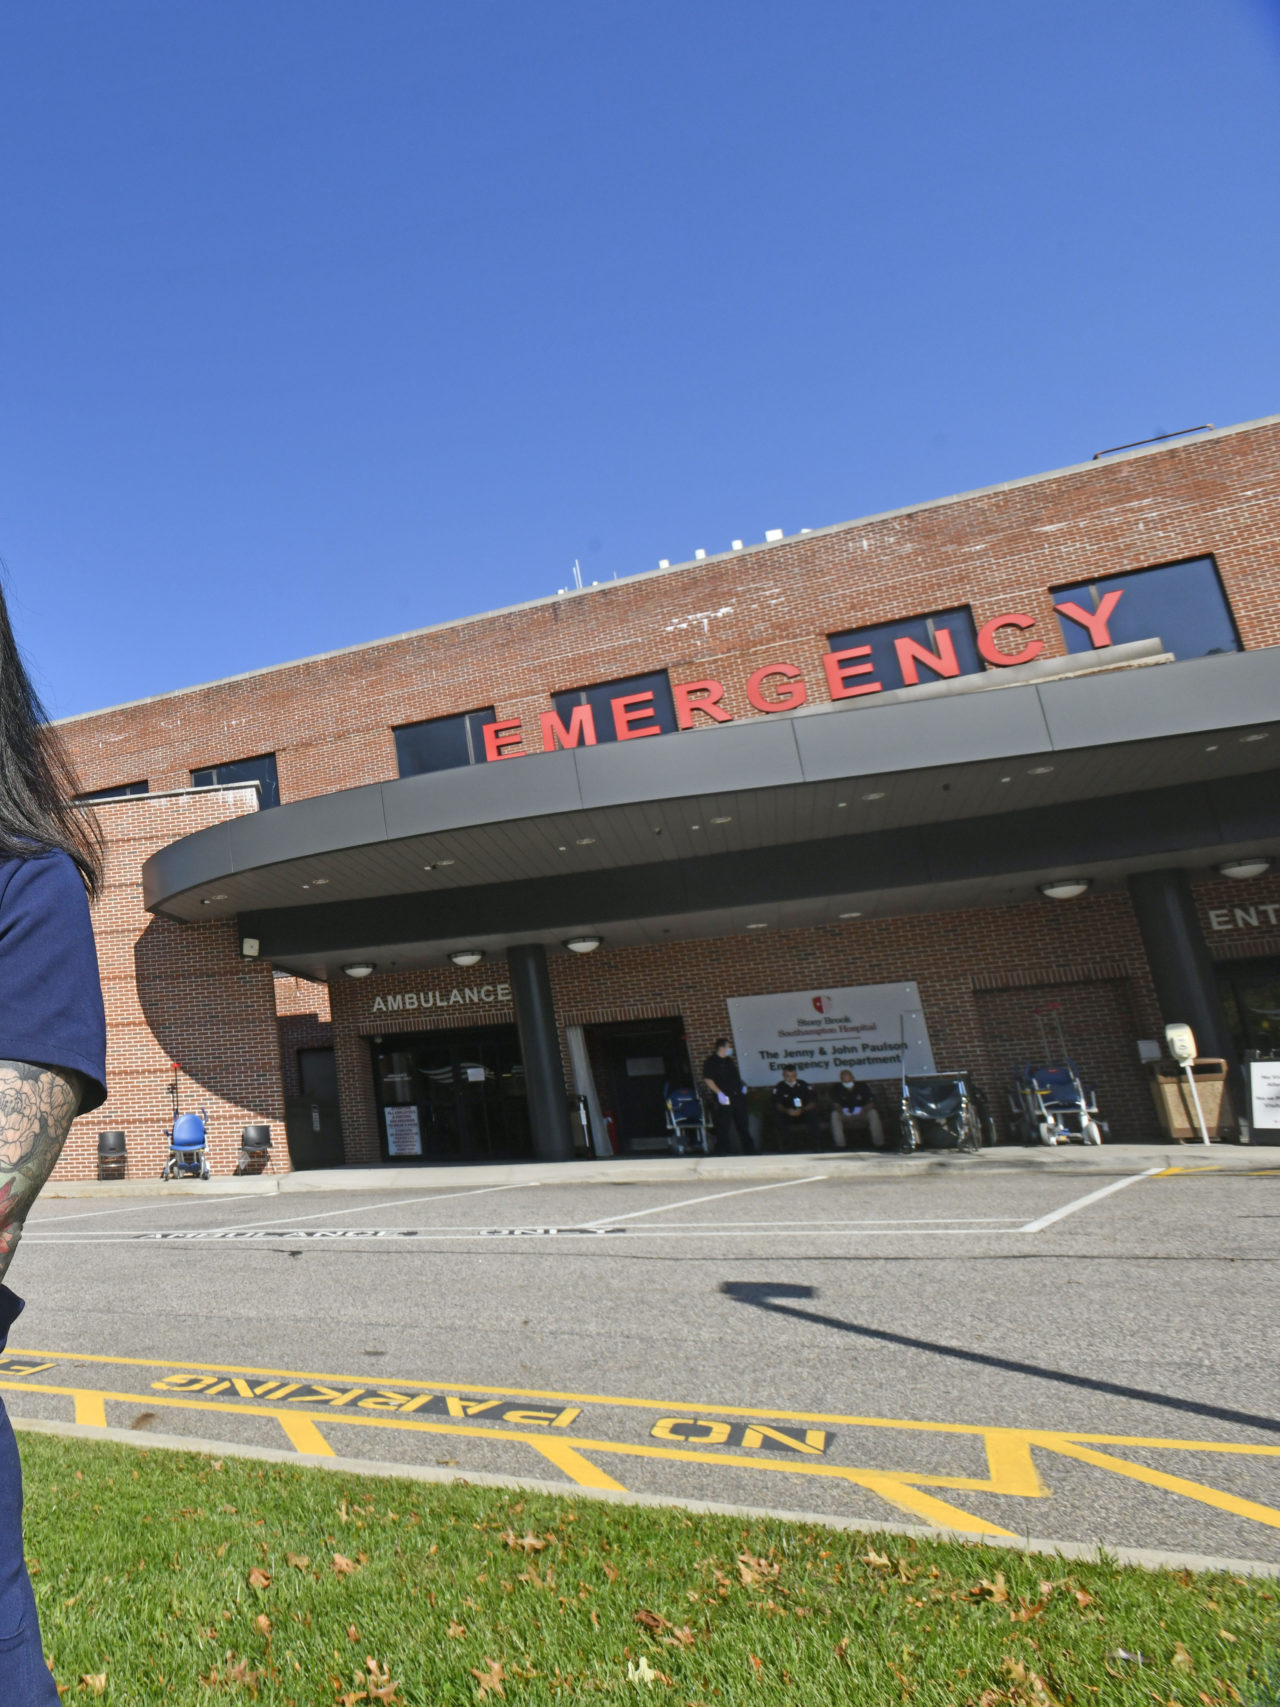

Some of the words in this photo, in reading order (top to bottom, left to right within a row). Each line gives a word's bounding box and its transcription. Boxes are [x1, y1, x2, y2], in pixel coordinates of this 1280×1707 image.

[481, 589, 1125, 763] EMERGENCY
[1208, 903, 1280, 930] ENT
[372, 983, 513, 1013] AMBULANCE
[759, 1050, 779, 1060] The
[783, 1048, 815, 1059] Jenny
[818, 1046, 827, 1056] &
[831, 1044, 858, 1056] John
[862, 1041, 908, 1053] Paulson
[833, 1053, 901, 1067] Department
[149, 1373, 583, 1428] PARKING
[650, 1416, 827, 1455] NO
